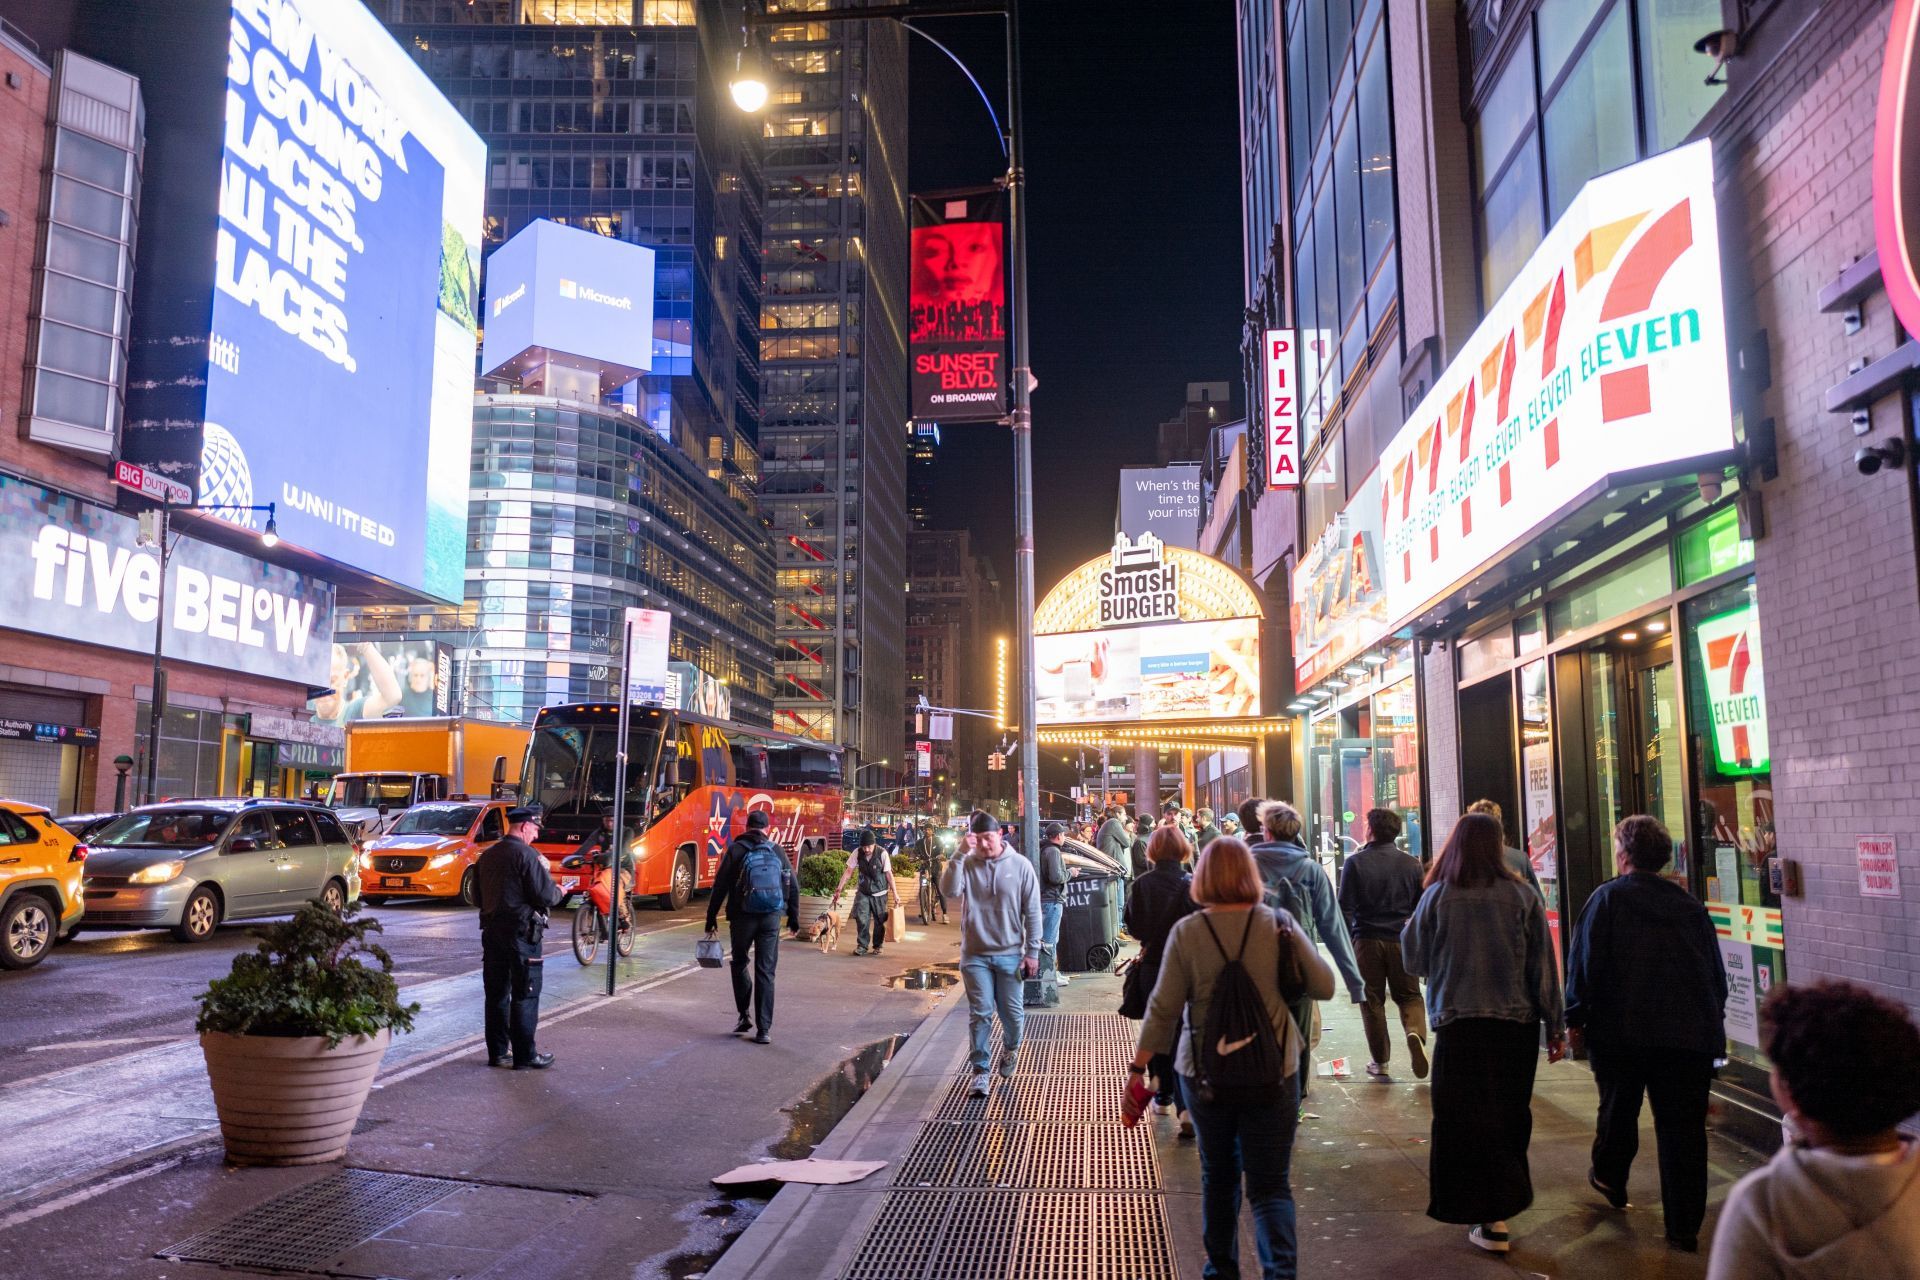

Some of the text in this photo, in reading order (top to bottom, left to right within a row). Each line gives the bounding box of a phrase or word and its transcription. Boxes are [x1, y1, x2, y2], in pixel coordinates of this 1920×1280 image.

[232, 0, 409, 174] EW YORK
[227, 17, 382, 202] S GOING
[224, 88, 364, 254] LACES.
[273, 196, 348, 301] THE
[215, 228, 356, 373] LACES.
[501, 283, 525, 309] Microsoft
[579, 286, 631, 310] Microsoft
[916, 353, 999, 374] SUNSET
[941, 370, 998, 389] BLVD.
[1418, 415, 1442, 563] 7
[1446, 374, 1476, 538] 7
[1481, 326, 1516, 508] 7
[1522, 266, 1566, 471] 7
[1574, 197, 1693, 423] 7
[930, 392, 997, 404] ON BROADWAY
[1273, 340, 1295, 474] PIZZA
[120, 464, 140, 485] BIG
[1136, 480, 1200, 491] When's the
[1158, 494, 1199, 504] time to
[1148, 507, 1200, 520] your insti
[31, 524, 314, 657] five BELOW
[1101, 593, 1176, 622] BURGER
[1707, 631, 1750, 764] 7
[0, 727, 20, 737] Station
[4, 721, 33, 731] Authority
[291, 743, 318, 764] PIZZA
[1530, 767, 1549, 792] FREE
[1859, 841, 1893, 855] SPRINKLERS
[1859, 858, 1895, 873] THROUGHOUT
[1866, 875, 1893, 890] BUILDING
[1063, 894, 1091, 907] TALY
[1741, 908, 1753, 941] 7
